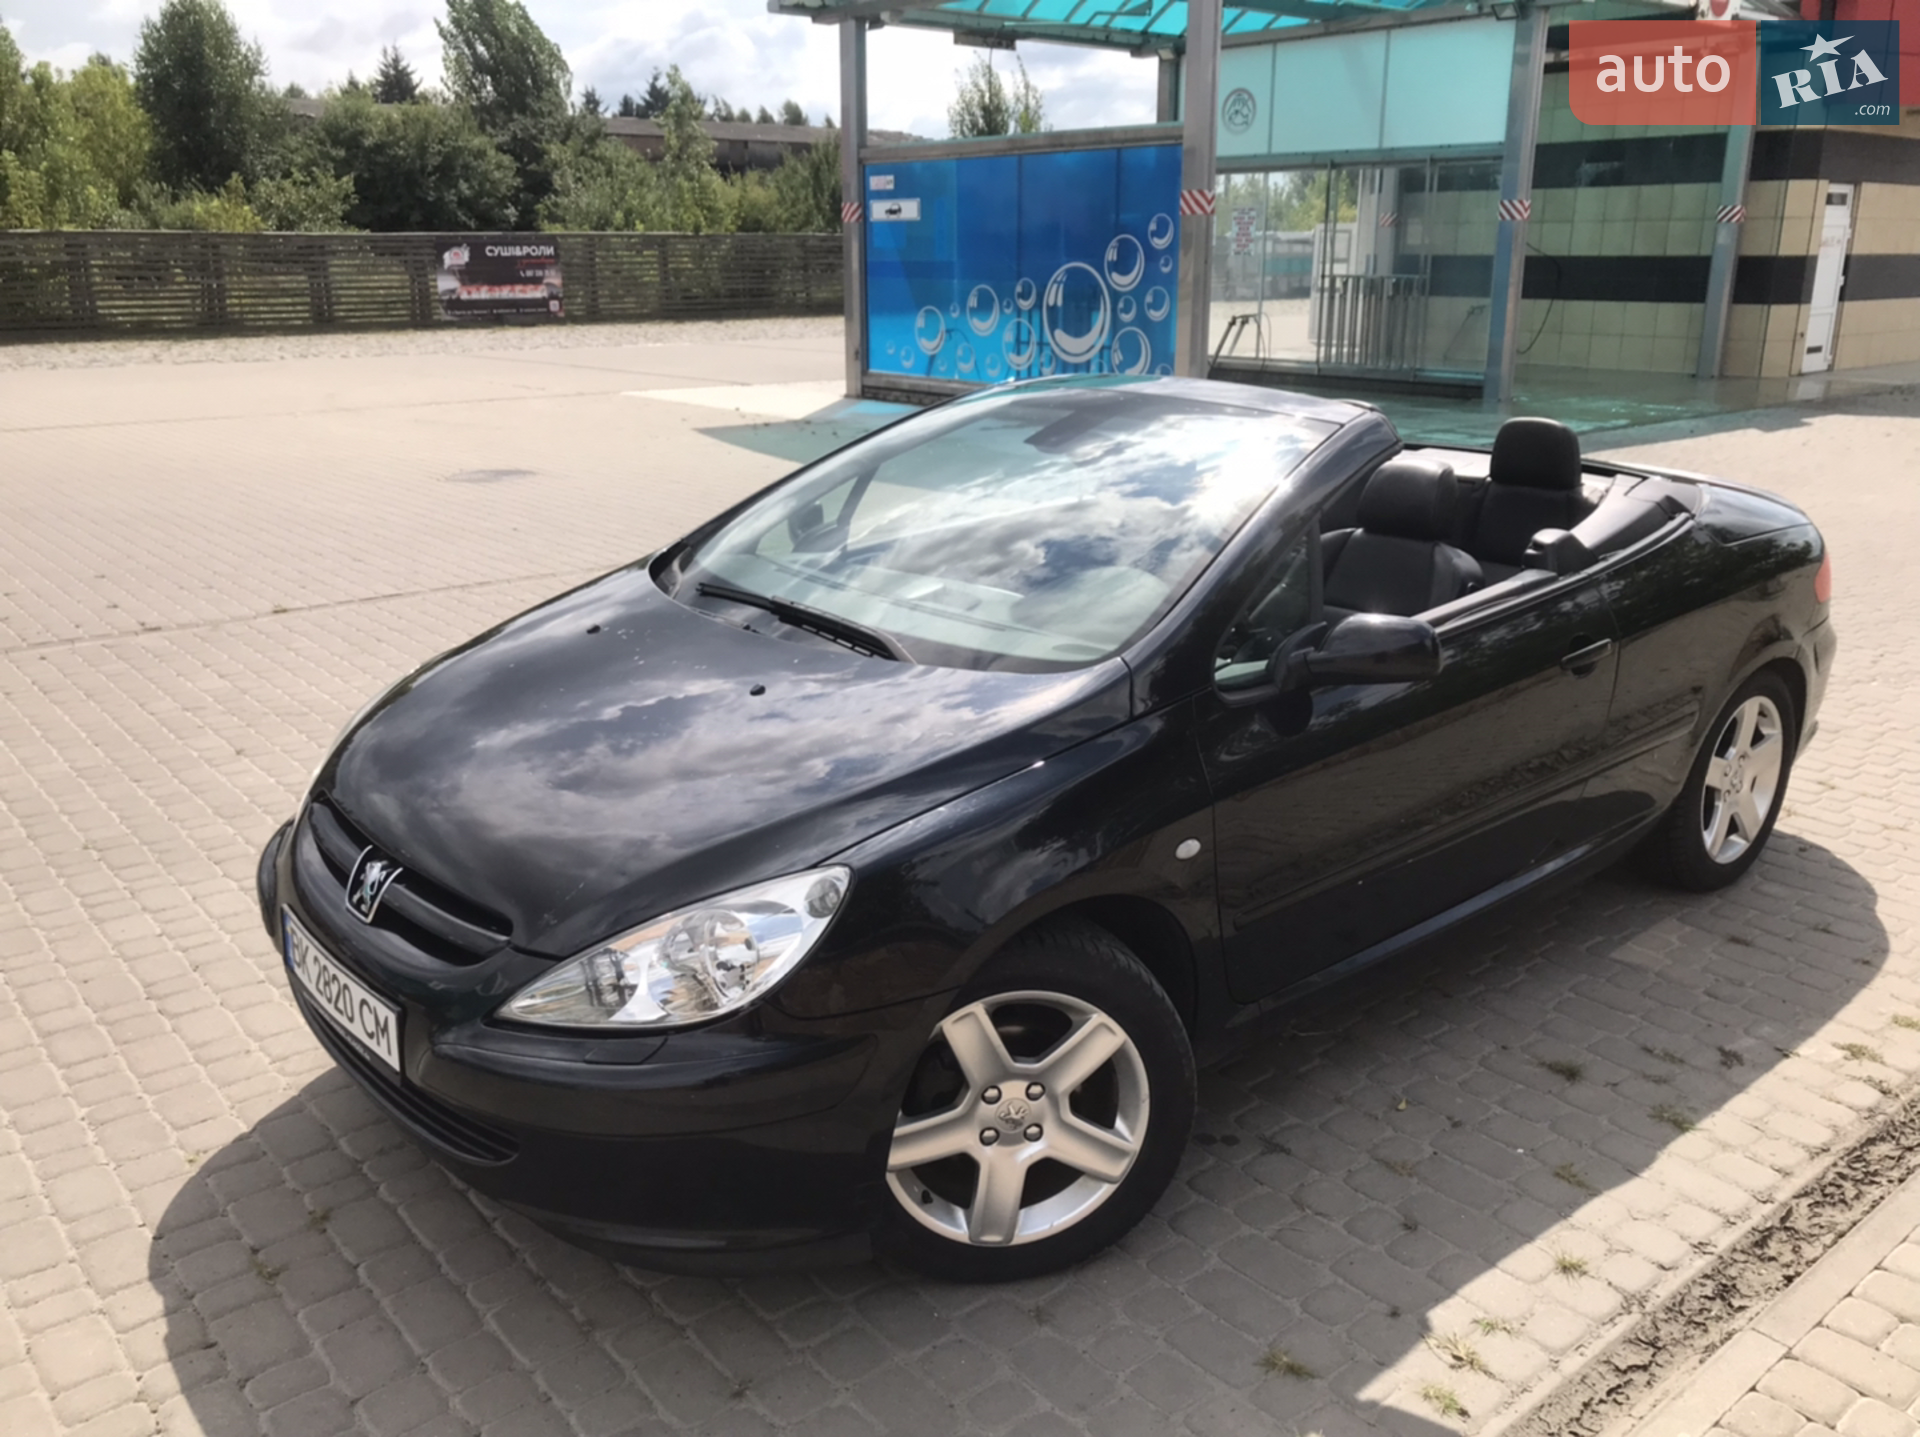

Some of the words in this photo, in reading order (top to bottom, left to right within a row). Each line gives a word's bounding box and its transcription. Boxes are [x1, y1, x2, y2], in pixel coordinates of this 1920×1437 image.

[290, 926, 313, 984] BK
[313, 955, 355, 1024] 2820
[359, 997, 392, 1057] CM
